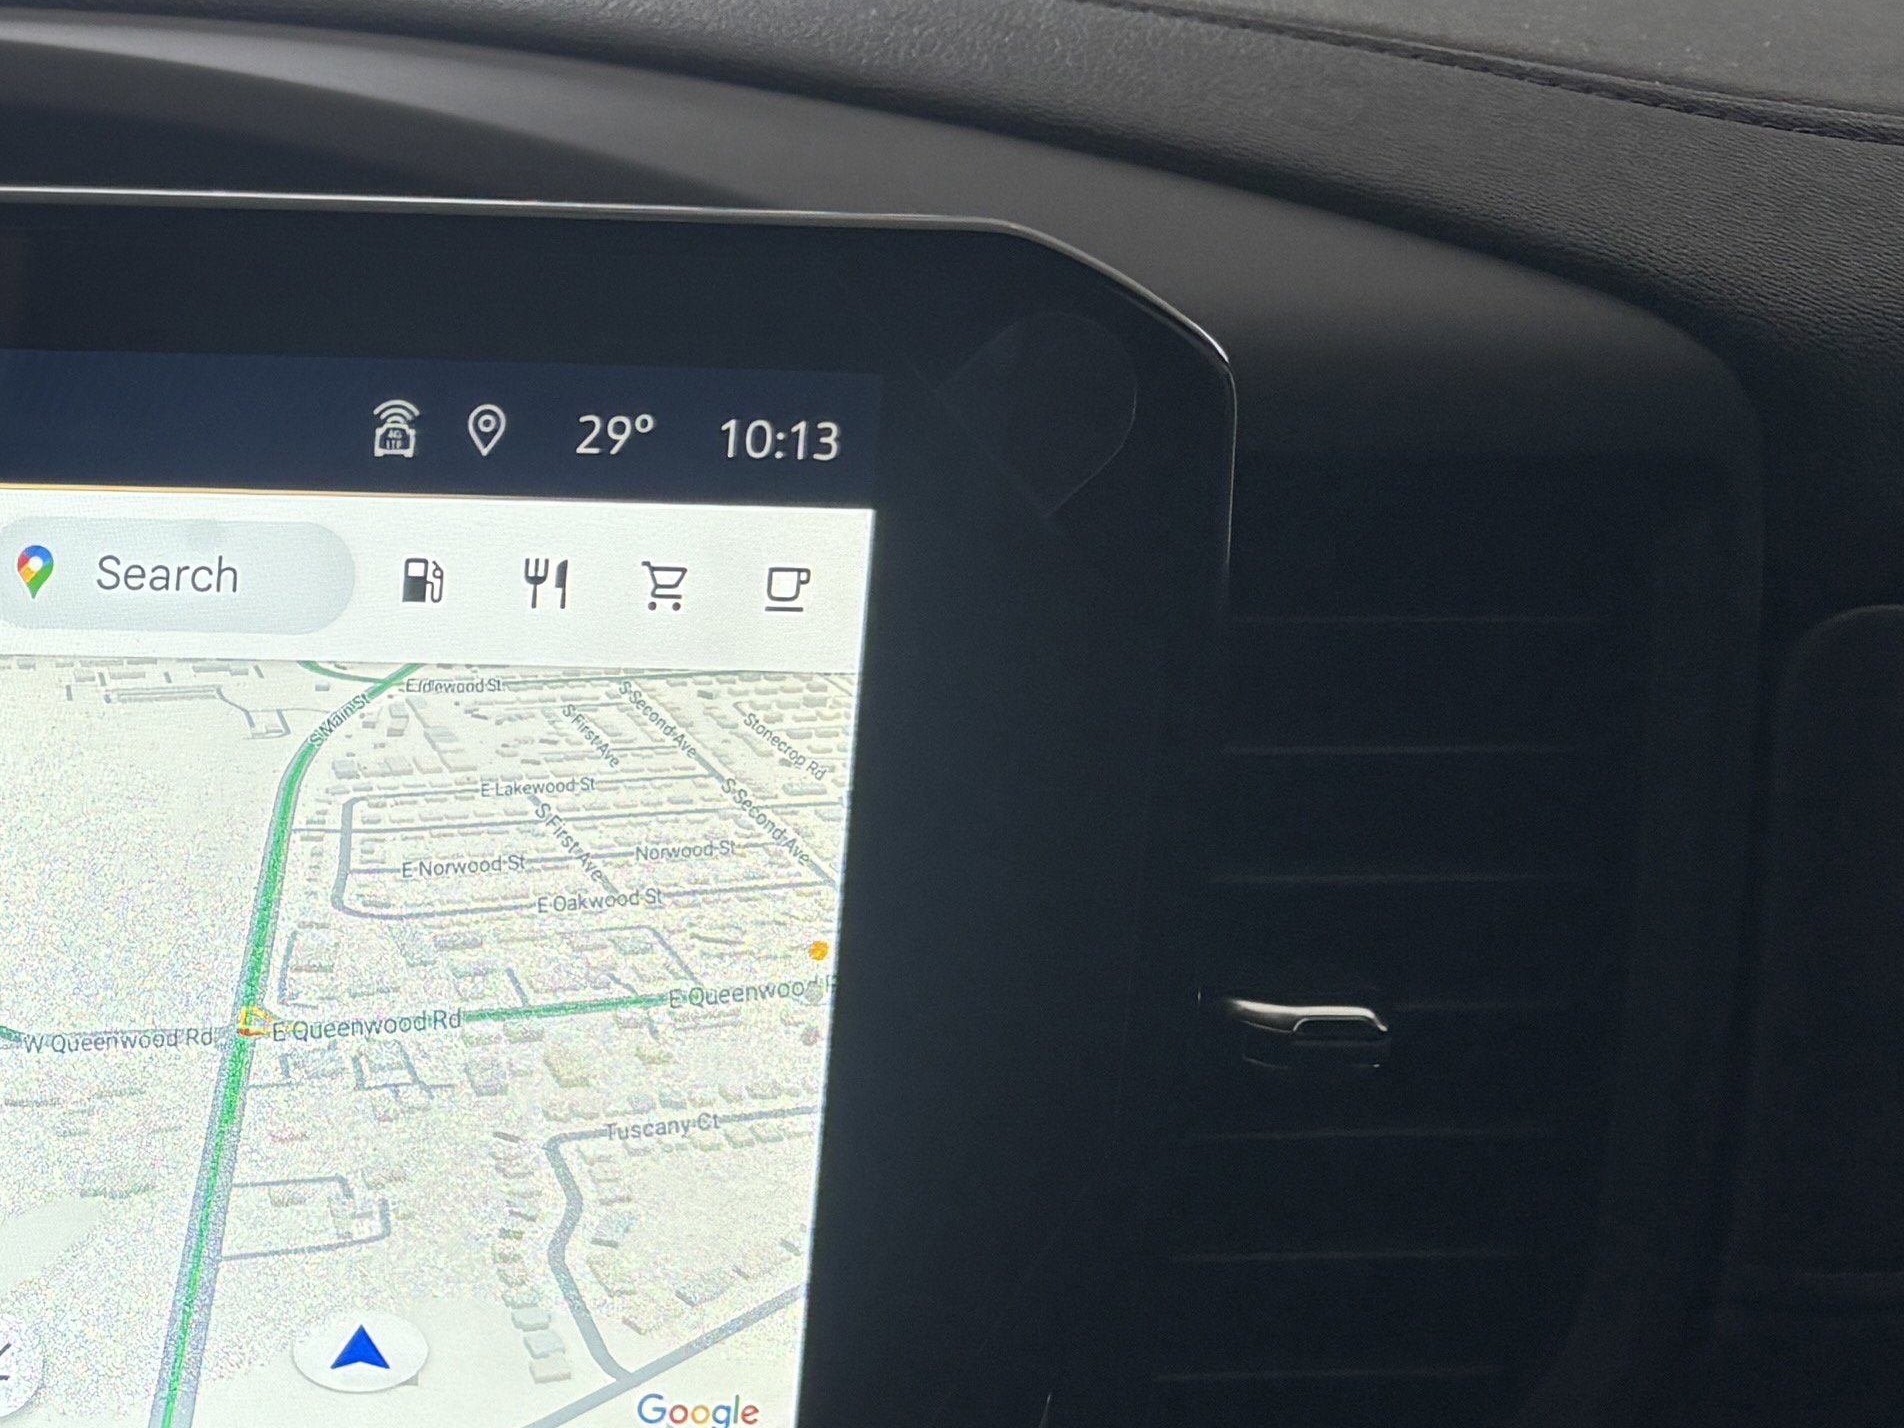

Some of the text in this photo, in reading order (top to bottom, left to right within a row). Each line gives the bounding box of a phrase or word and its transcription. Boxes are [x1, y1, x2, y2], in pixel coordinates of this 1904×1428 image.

[720, 418, 840, 461] 10:13
[96, 555, 238, 593] Search
[308, 693, 370, 748] S Main St
[562, 703, 620, 768] S First Ave
[619, 680, 697, 759] S Second Ave
[743, 712, 827, 781] Stonecrop Rd
[481, 776, 596, 798] E Lakewood St
[720, 778, 810, 866] S Second Ave
[535, 802, 604, 882] S First Ave
[635, 839, 737, 862] Norwood St
[402, 853, 526, 879] E Norwood St
[537, 887, 663, 914] E Oakwood St
[669, 989, 682, 1009] E
[23, 1027, 214, 1055] W Queenwood Rd
[273, 1008, 463, 1044] E Queenwood Rd
[607, 1112, 721, 1141] Tuscany Ct
